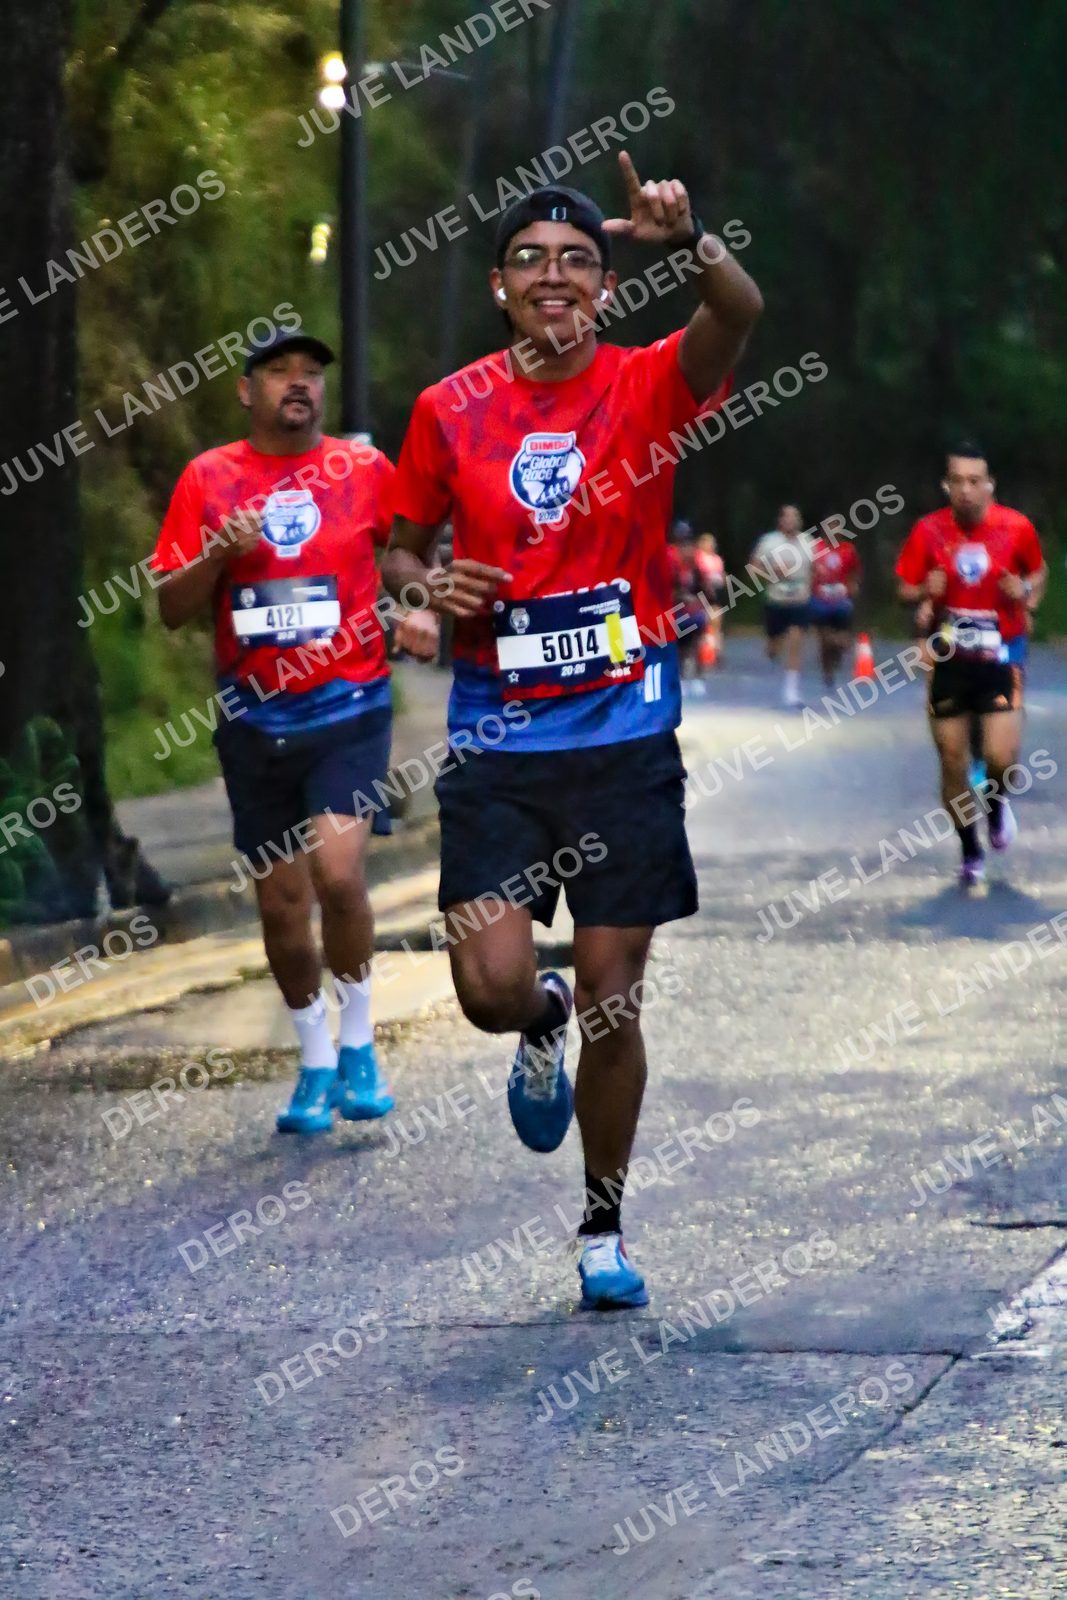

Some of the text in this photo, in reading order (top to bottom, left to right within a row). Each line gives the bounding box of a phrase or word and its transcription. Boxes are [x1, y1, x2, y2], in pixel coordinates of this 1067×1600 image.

[530, 455, 568, 469] Global
[521, 468, 553, 481] Race
[266, 605, 303, 628] 4121
[541, 628, 600, 663] 5014
